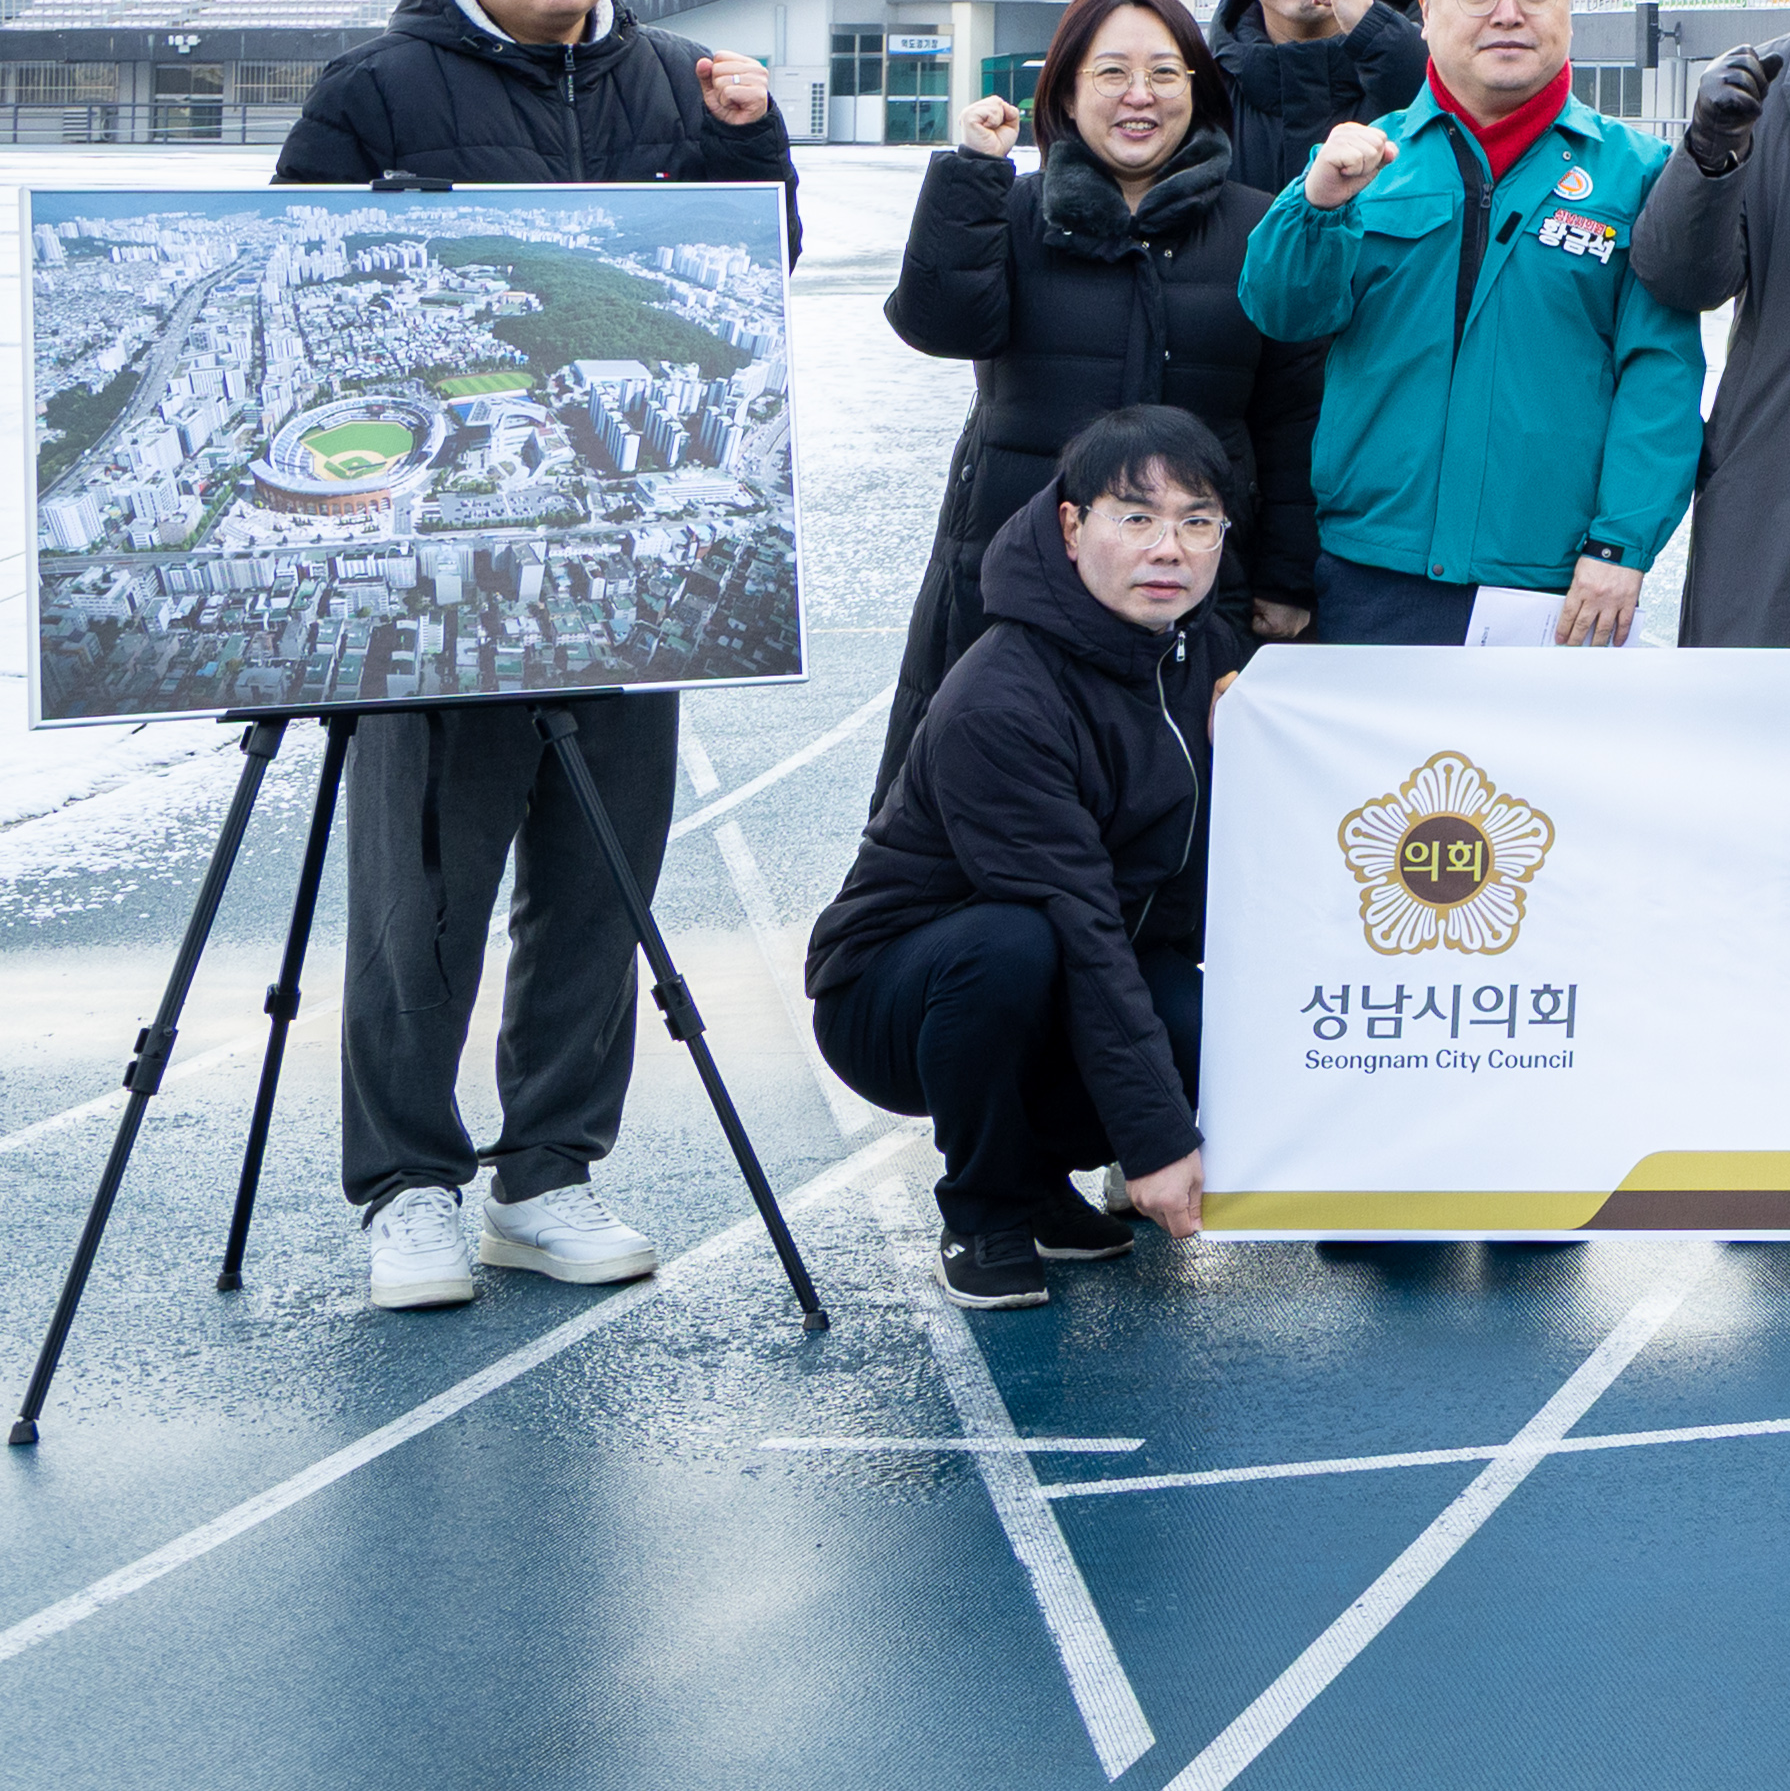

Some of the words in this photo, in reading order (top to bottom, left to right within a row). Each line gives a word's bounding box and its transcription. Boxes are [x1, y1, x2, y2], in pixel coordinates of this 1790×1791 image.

[1539, 218, 1616, 264] 황금석
[1403, 840, 1483, 883] 의회
[1300, 983, 1578, 1041] 성남시의회
[1305, 1050, 1428, 1074] Seongnam
[1436, 1050, 1481, 1073] City
[1488, 1050, 1574, 1069] Council
